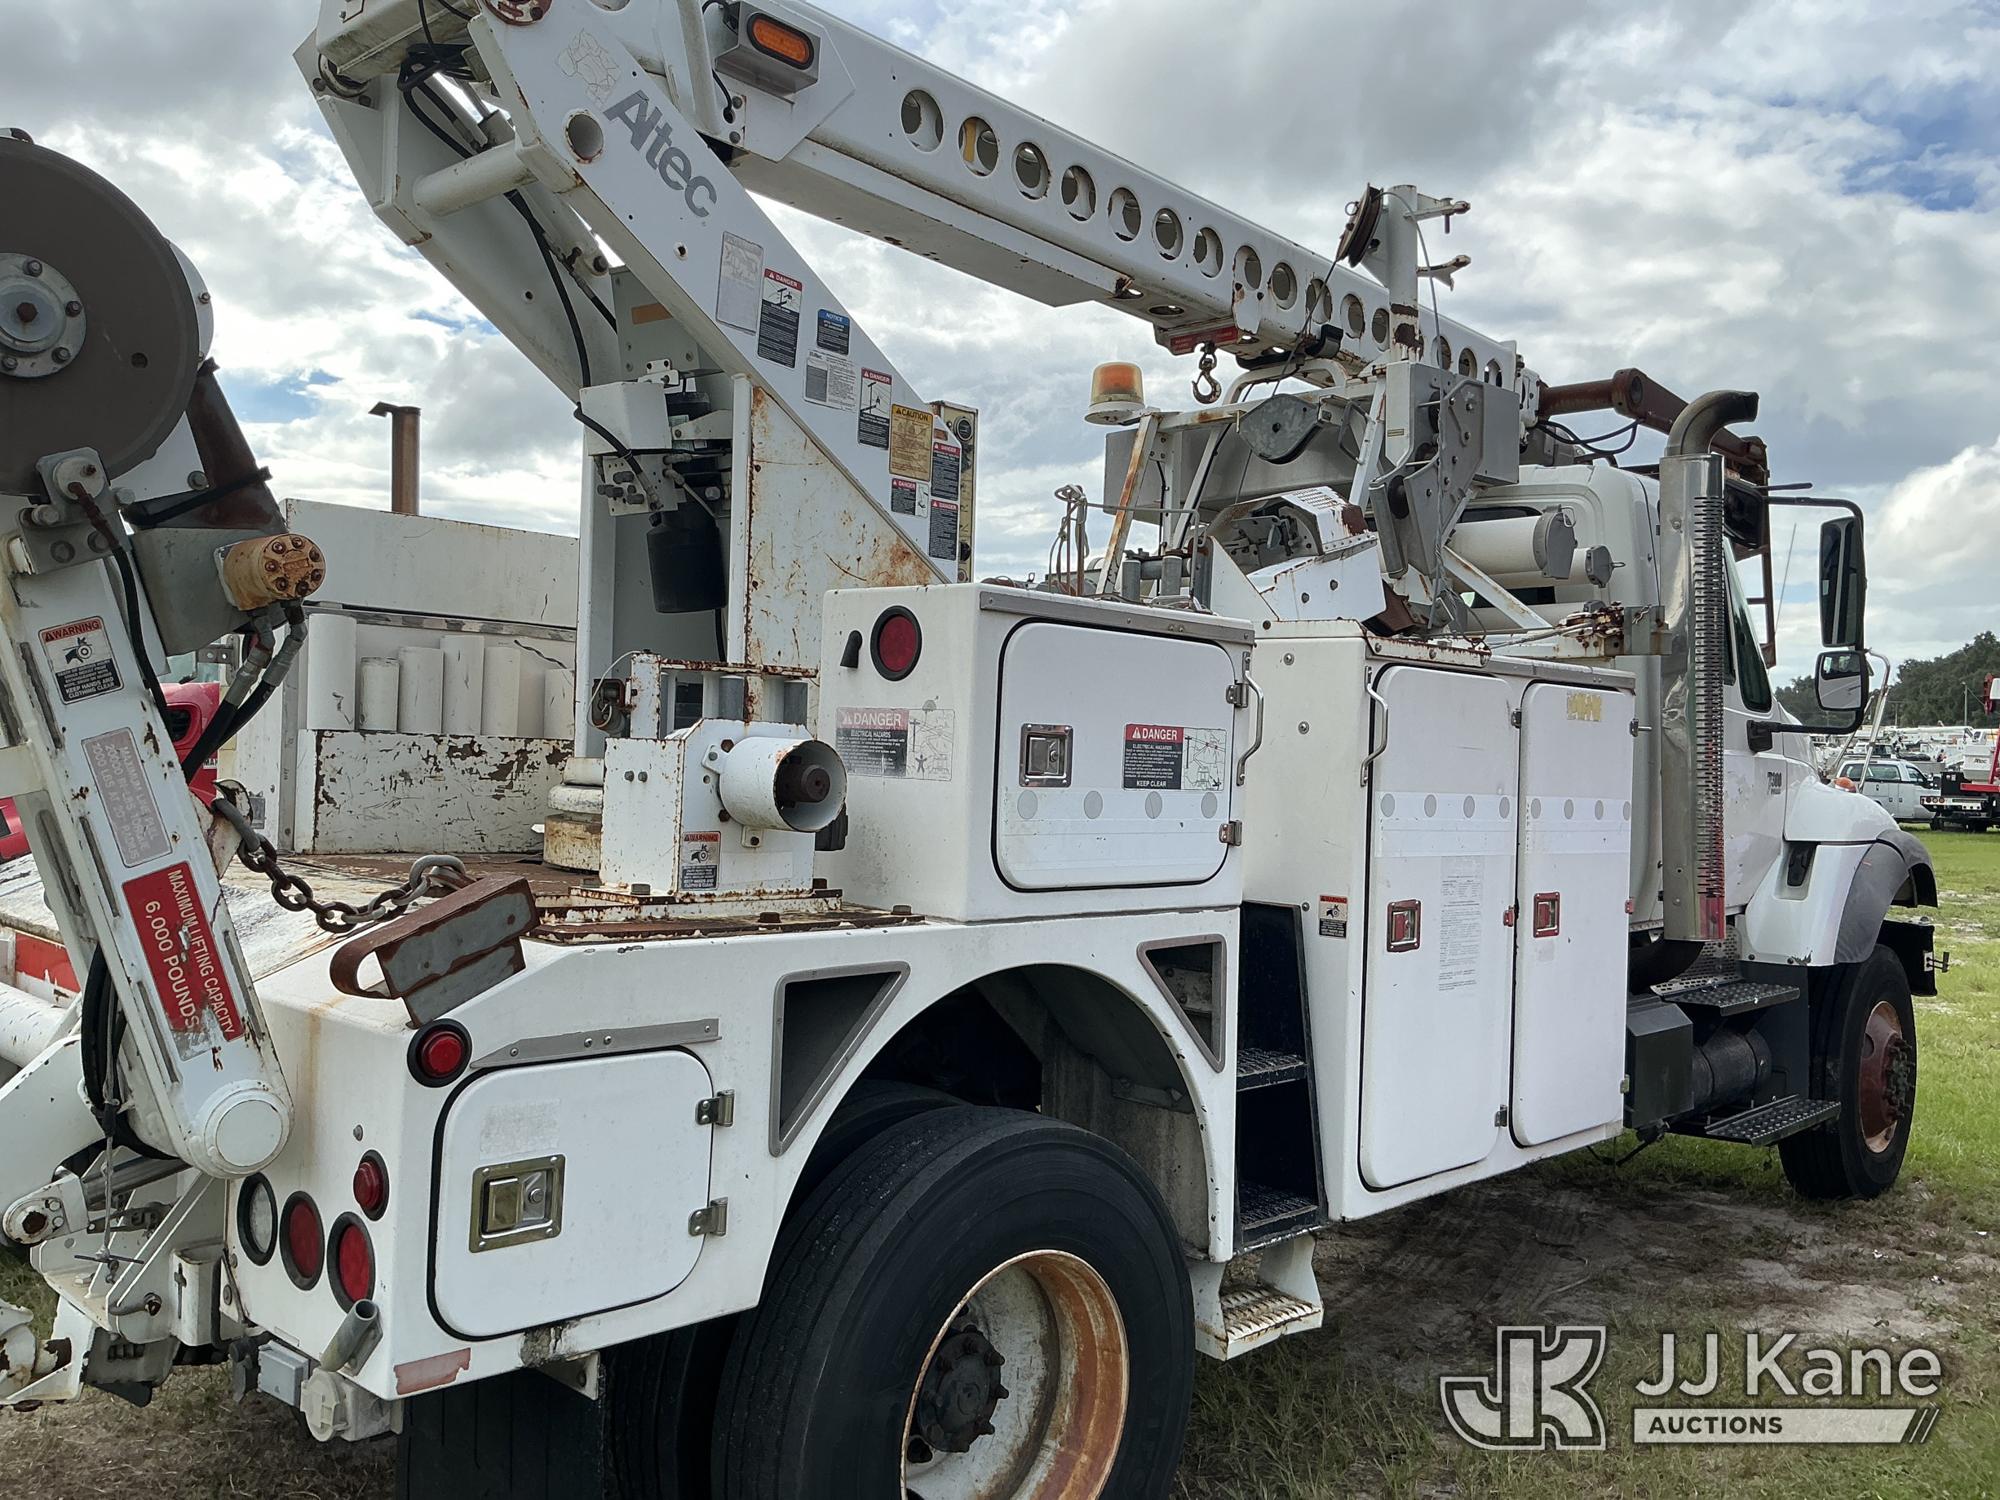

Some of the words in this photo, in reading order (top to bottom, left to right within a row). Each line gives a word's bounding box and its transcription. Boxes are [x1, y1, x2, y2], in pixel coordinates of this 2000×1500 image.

[603, 89, 717, 217] Altec
[901, 408, 929, 421] CAUTION
[52, 620, 100, 637] WARNING
[65, 684, 81, 694] KEEP
[853, 712, 902, 727] DANGER
[1142, 728, 1178, 741] DANGER
[167, 869, 199, 928] MAXIMUM
[189, 928, 215, 977] LIFTING
[203, 977, 235, 1033] CAPACITY
[145, 900, 174, 952] 6,000
[163, 954, 200, 1029] POUNDS
